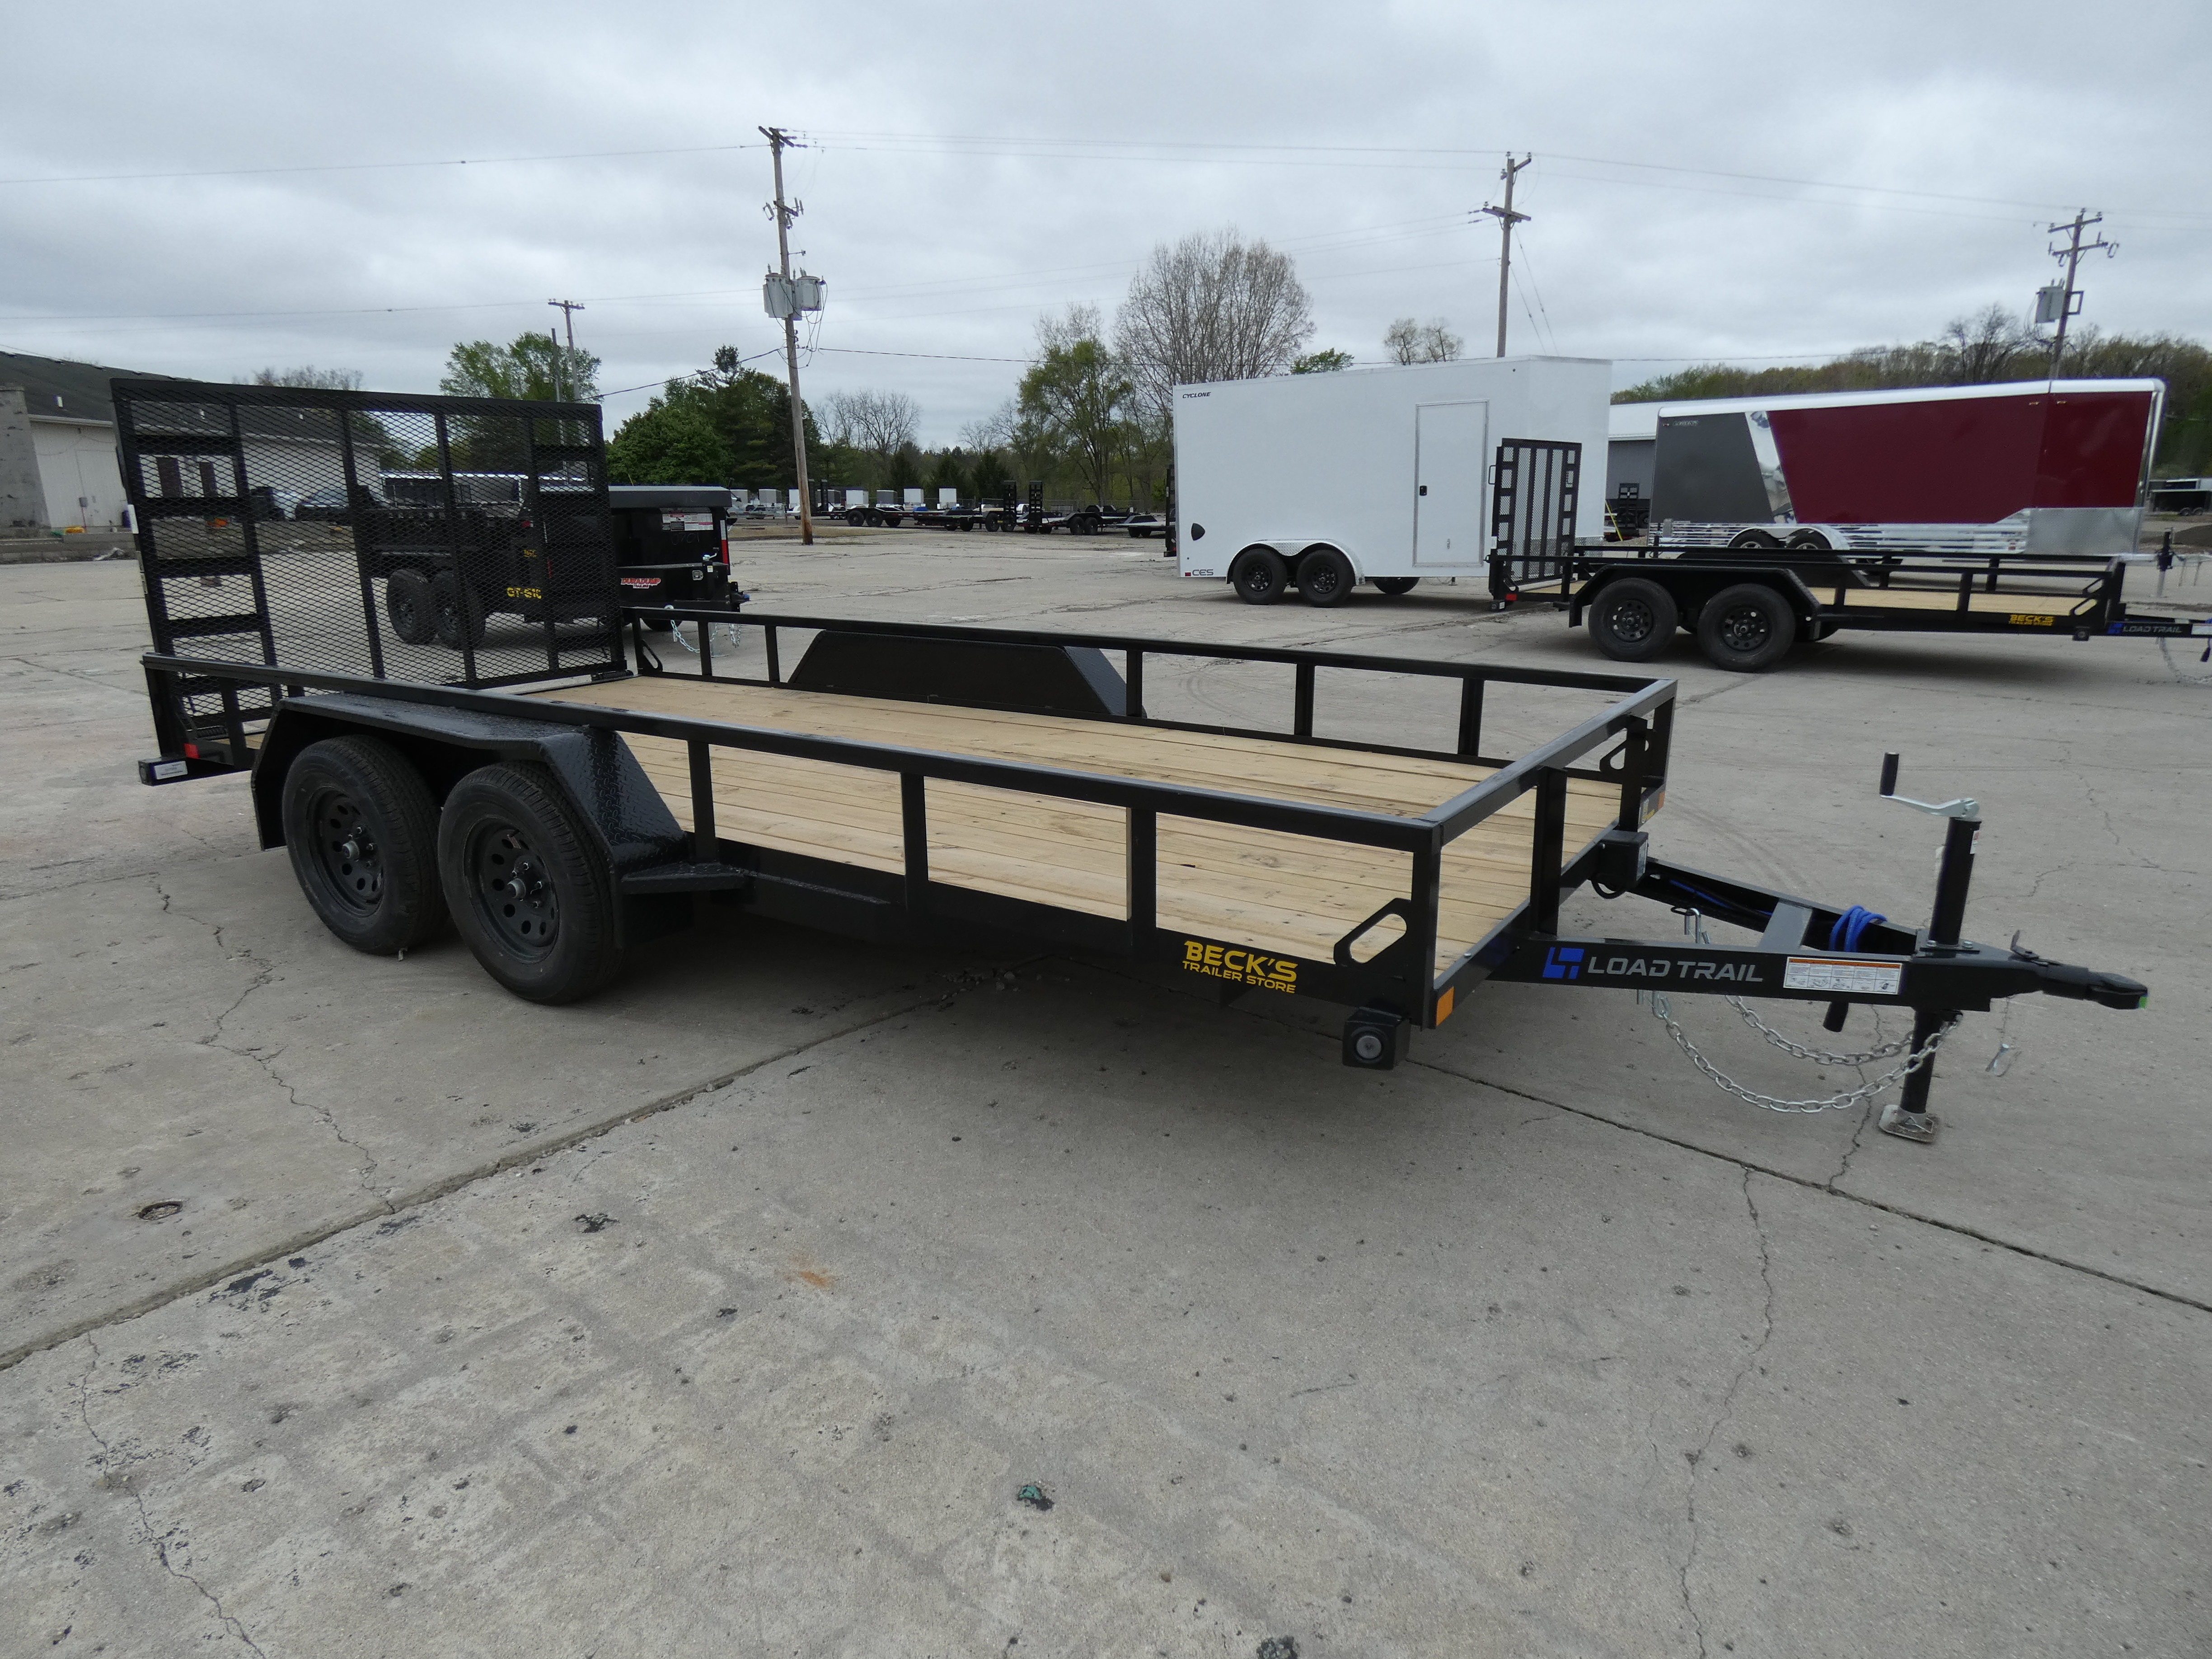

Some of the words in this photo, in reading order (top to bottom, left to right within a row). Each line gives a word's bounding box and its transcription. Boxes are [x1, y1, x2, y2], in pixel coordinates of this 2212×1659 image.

[2010, 614, 2054, 623] BECK'S
[1184, 941, 1298, 982] BECK'S
[1588, 956, 1671, 977] LOAD
[1677, 961, 1763, 982] TRAIL
[1182, 961, 1242, 982] TRAILER
[1246, 975, 1296, 994] STORE
